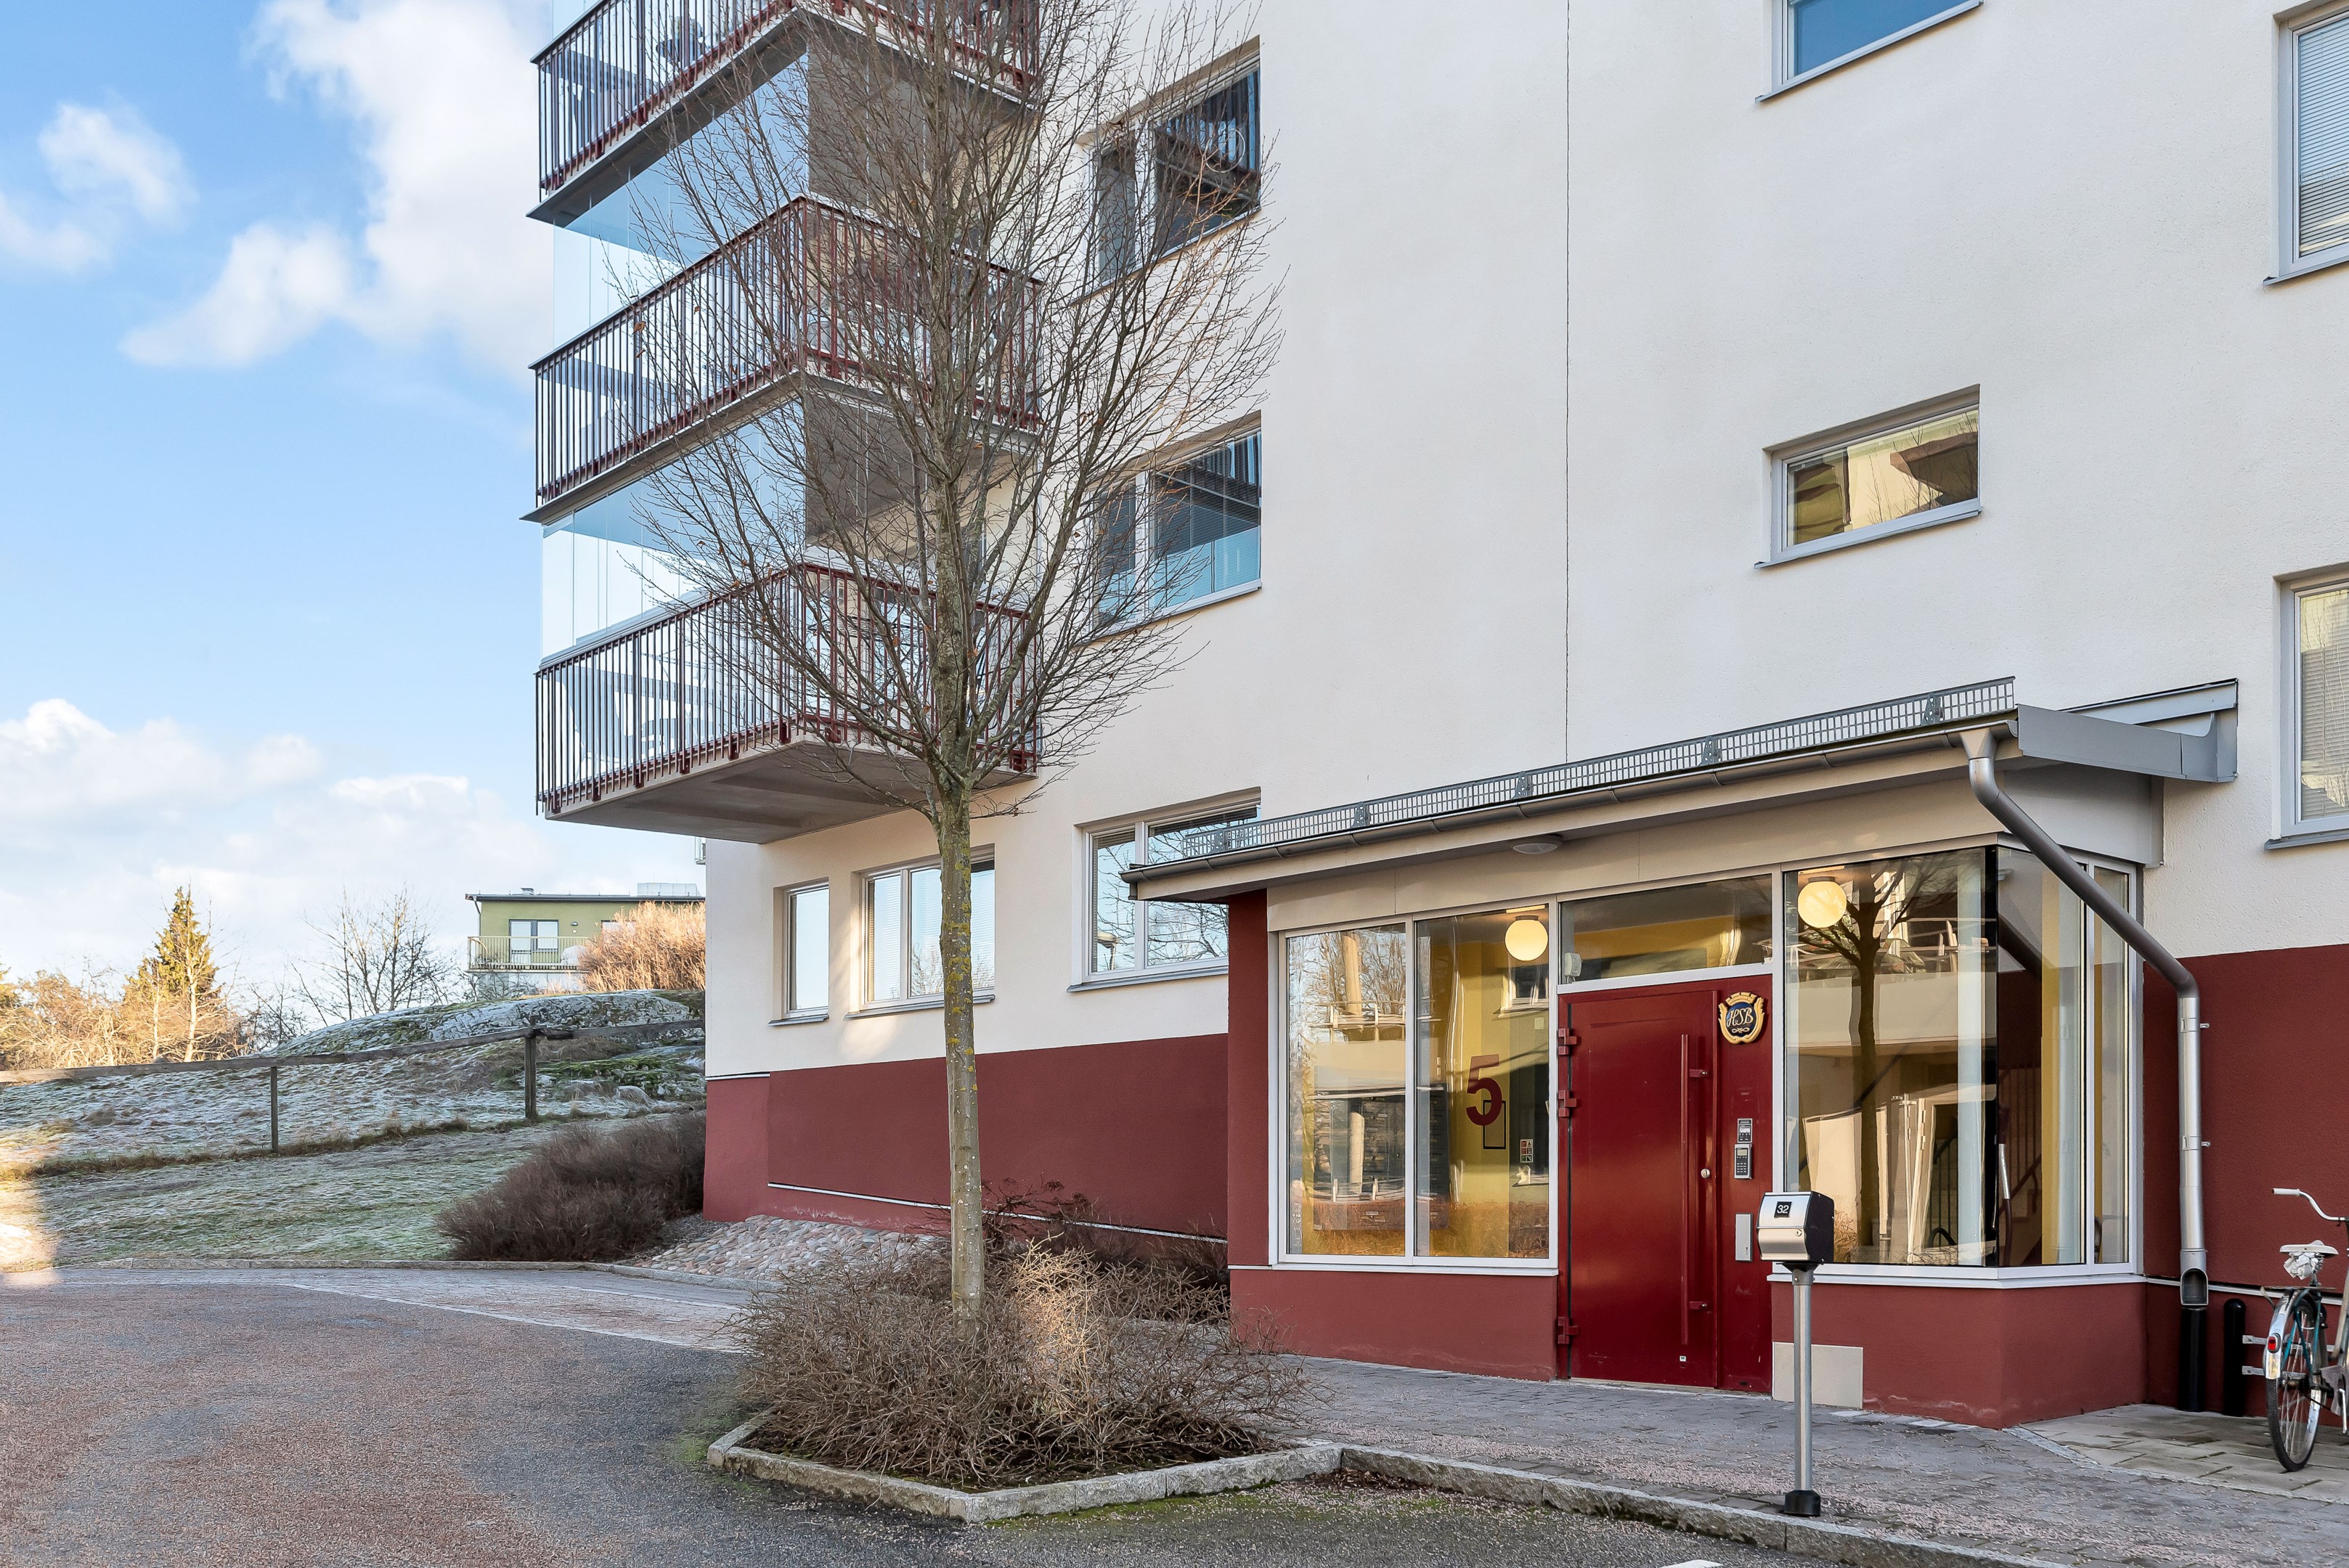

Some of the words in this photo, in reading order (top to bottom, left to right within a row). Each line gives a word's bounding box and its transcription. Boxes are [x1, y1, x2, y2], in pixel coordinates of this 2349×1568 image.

[1727, 1008, 1754, 1027] HSB
[1465, 1053, 1503, 1126] 5
[1777, 1205, 1789, 1214] 32
